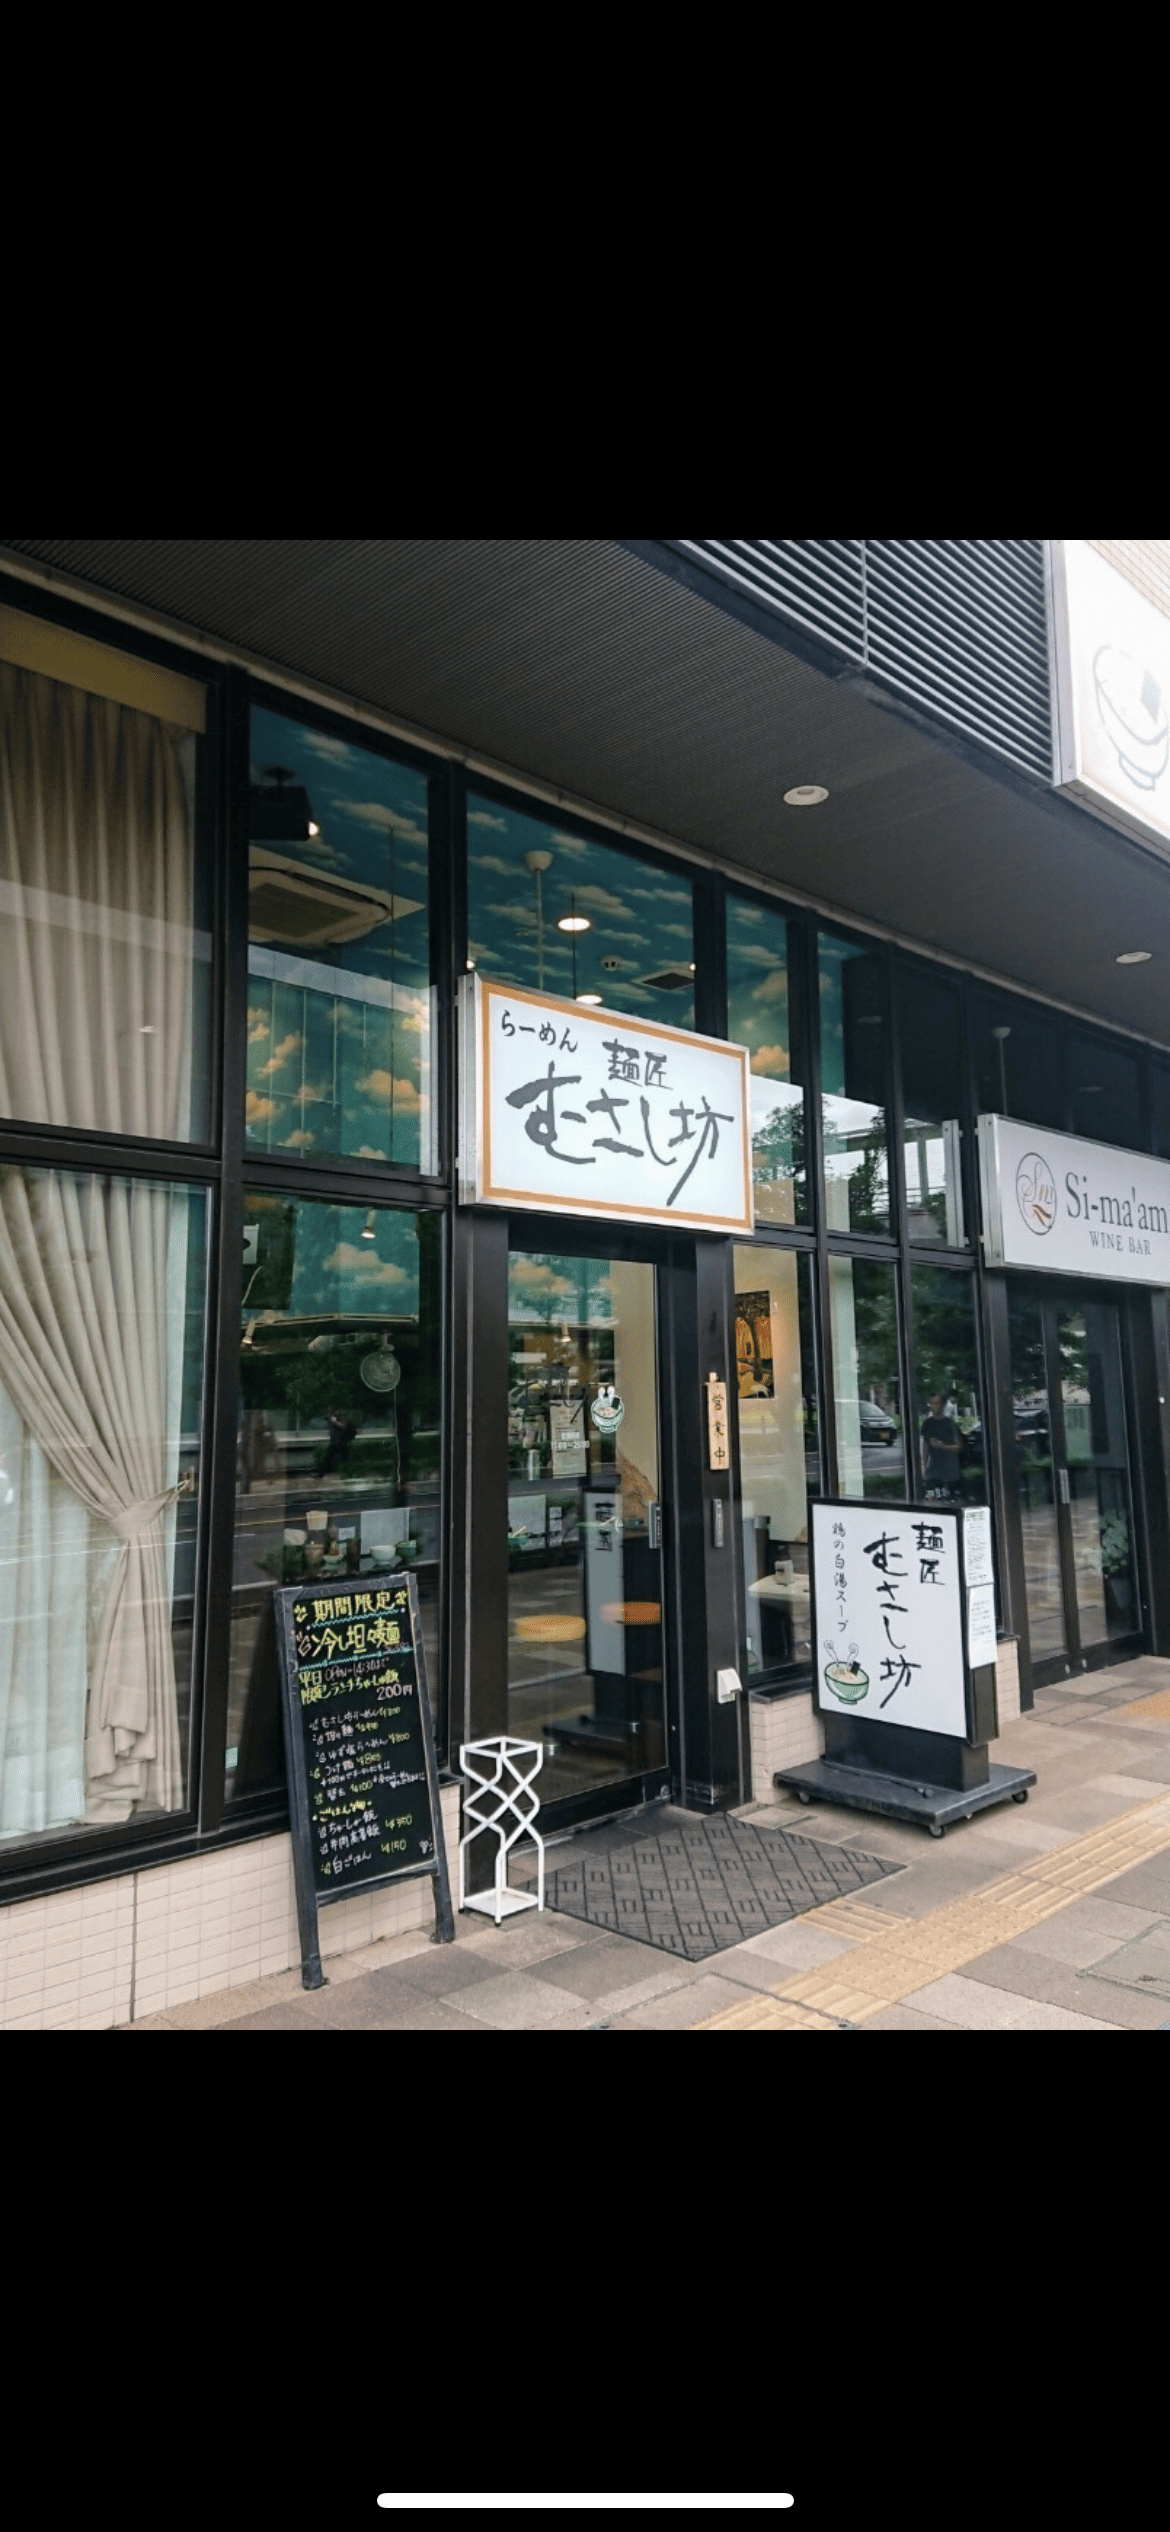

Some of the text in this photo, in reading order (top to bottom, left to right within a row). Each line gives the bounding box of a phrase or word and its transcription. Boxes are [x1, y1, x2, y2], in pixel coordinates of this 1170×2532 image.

[501, 1010, 578, 1053] らーめん
[602, 1039, 674, 1090] 麺匠
[505, 1060, 735, 1207] むさし坊
[1065, 1172, 1169, 1234] Si-ma'am
[1089, 1231, 1151, 1255] WINE BAR
[911, 1521, 946, 1586] 麺匠
[312, 1591, 395, 1622] 期間限定
[863, 1531, 922, 1709] むさし坊
[299, 1670, 322, 1688] 平日
[377, 1685, 412, 1700] 200円
